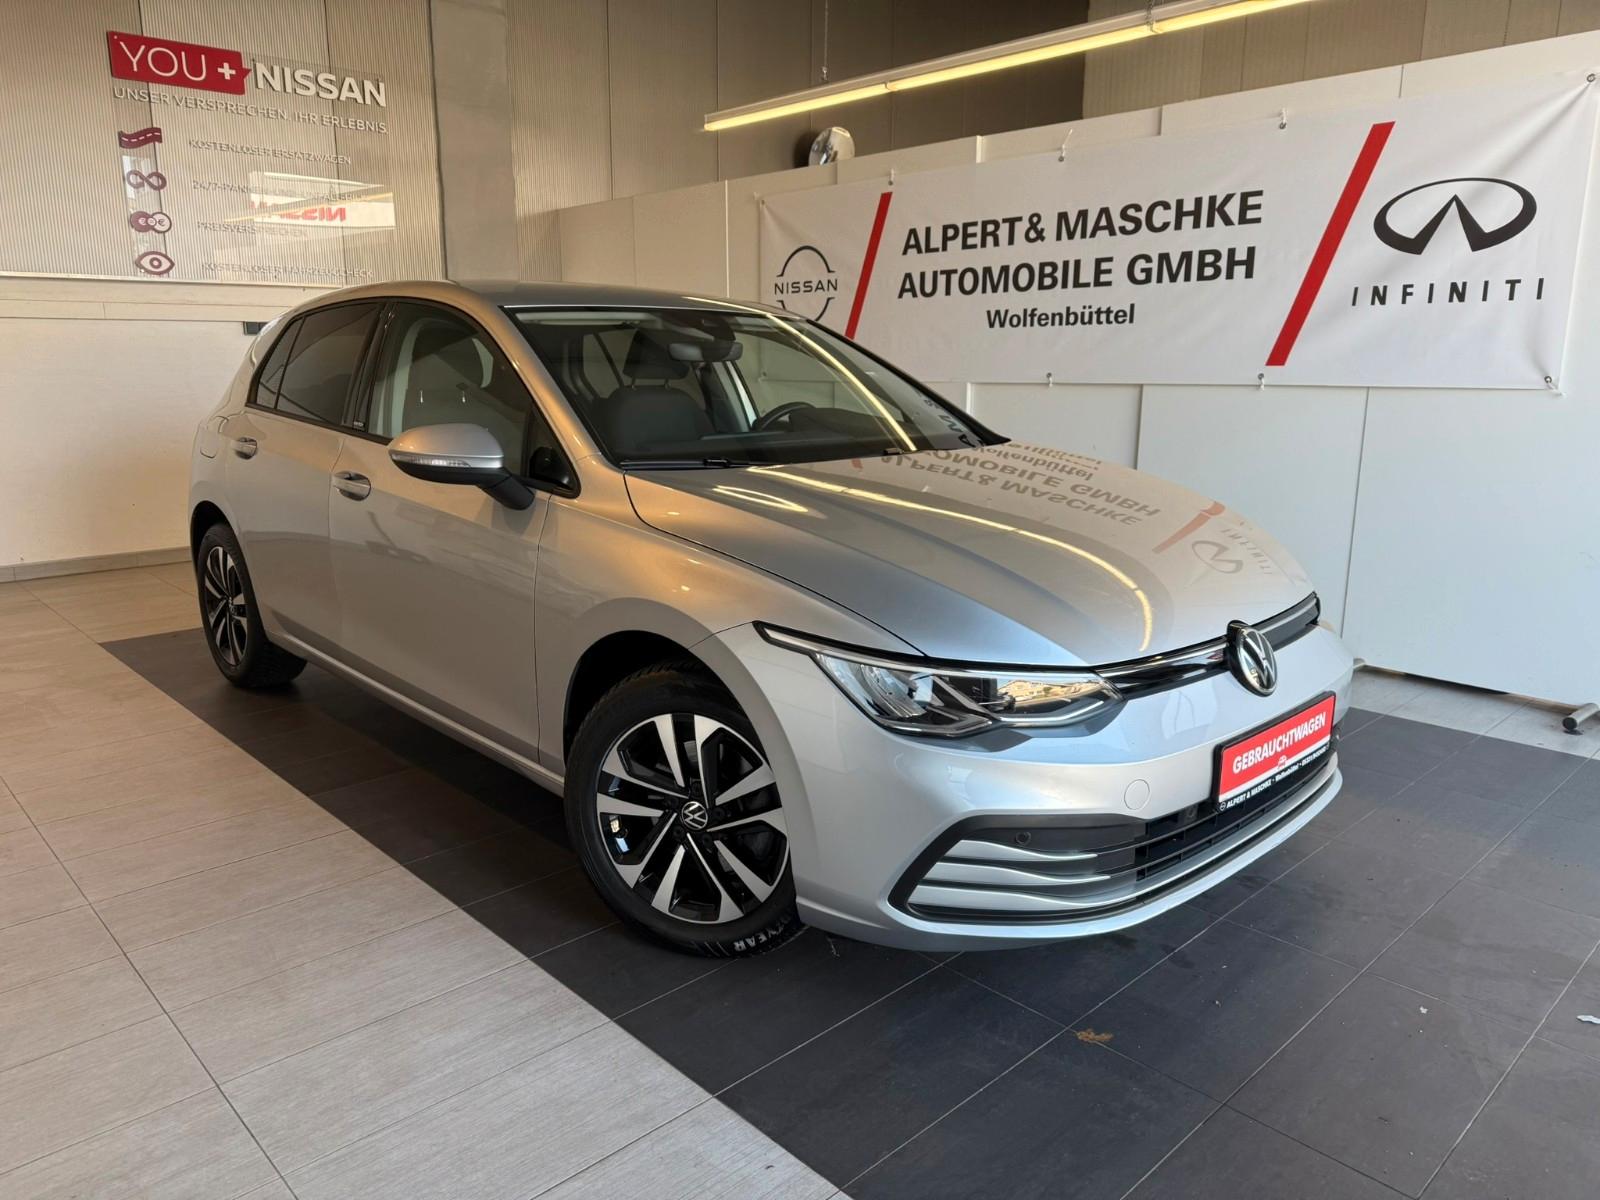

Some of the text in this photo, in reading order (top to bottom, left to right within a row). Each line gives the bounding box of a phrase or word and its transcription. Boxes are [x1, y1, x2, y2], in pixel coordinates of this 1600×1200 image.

[119, 41, 207, 82] YOU
[255, 61, 386, 107] NISSAN
[113, 87, 170, 105] UNSER
[294, 111, 319, 126] IHR
[1056, 190, 1264, 242] MASCHKE
[774, 278, 838, 295] NISSAN
[897, 246, 1256, 299] AUTOMOBILE GMBH
[1351, 277, 1545, 306] INFINITI
[986, 303, 1135, 329] Wolfenbüttel
[1232, 711, 1327, 774] GEBRAUCHTWAGEN
